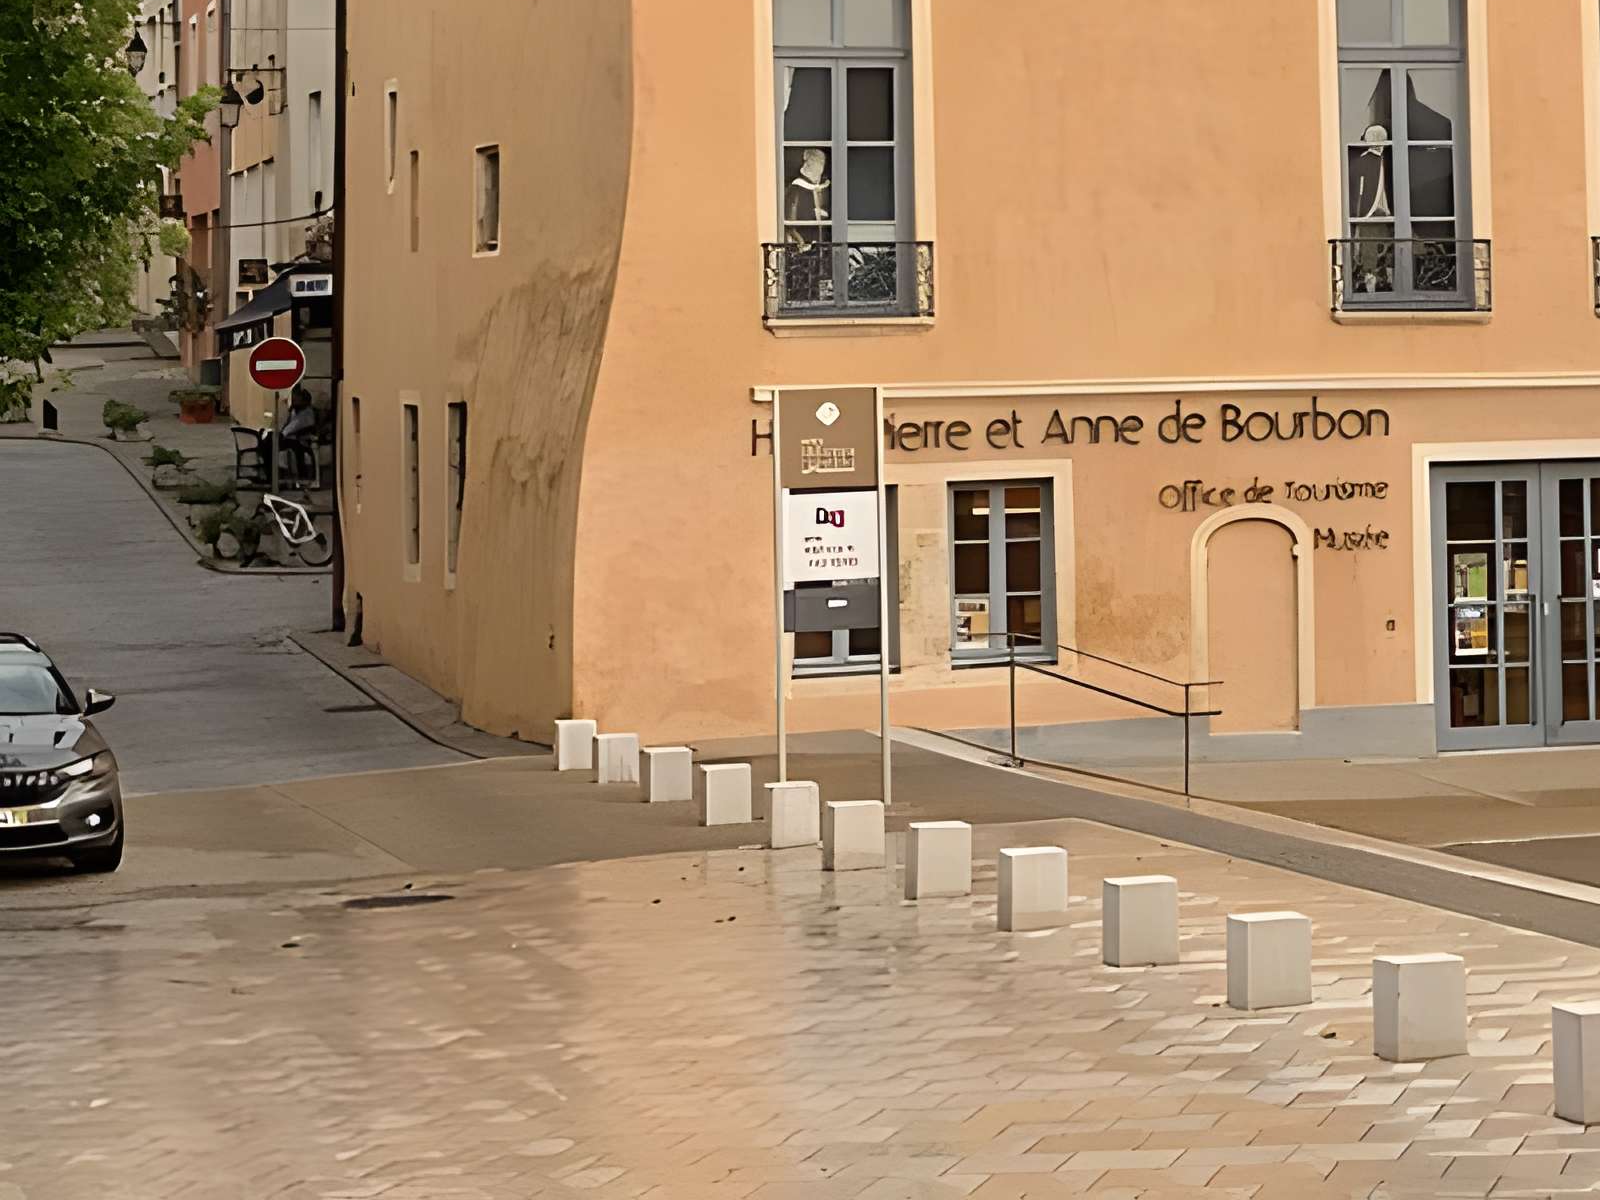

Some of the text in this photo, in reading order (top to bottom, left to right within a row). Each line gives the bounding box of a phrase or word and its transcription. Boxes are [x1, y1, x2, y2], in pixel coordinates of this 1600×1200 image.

[986, 409, 1024, 449] et
[1041, 408, 1144, 446] Anne
[1158, 399, 1207, 444] de
[1220, 395, 1390, 442] Bourbon
[1244, 476, 1274, 503] de
